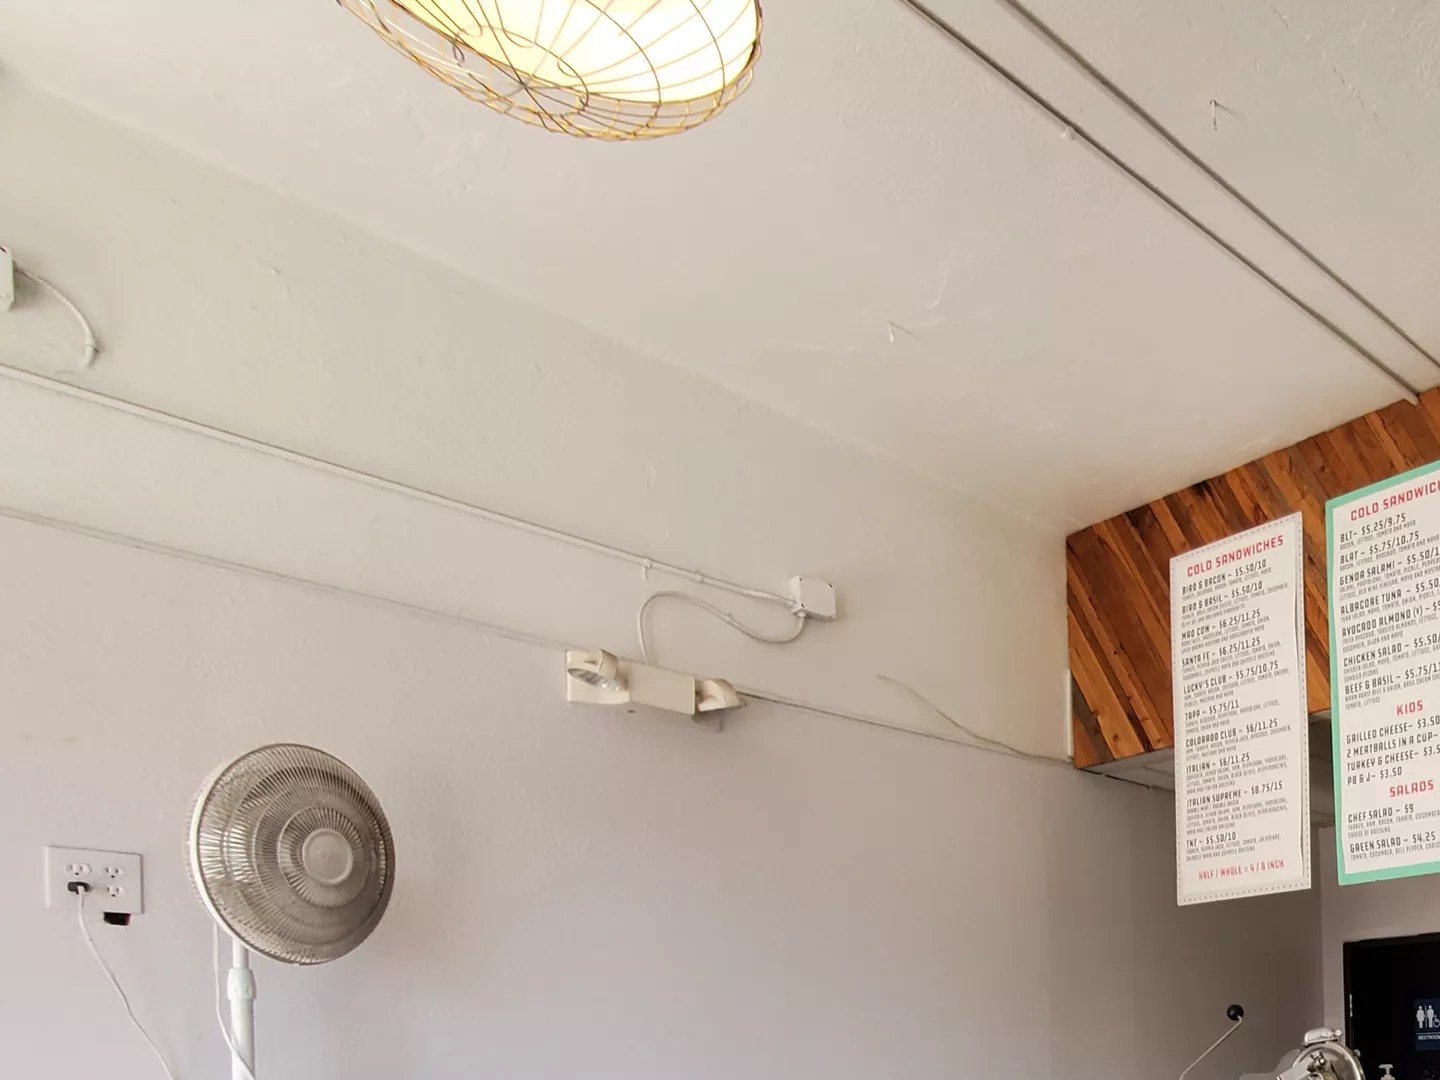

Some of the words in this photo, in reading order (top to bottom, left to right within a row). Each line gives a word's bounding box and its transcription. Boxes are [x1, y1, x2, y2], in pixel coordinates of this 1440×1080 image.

[1351, 502, 1379, 521] COLD
[1187, 560, 1212, 577] COLD
[1215, 535, 1283, 568] SANDWICHES
[1340, 570, 1365, 586] GENOA
[1367, 560, 1395, 578] SALAMI
[1340, 595, 1379, 615] ALBACORE
[1381, 589, 1402, 603] TUNA
[1183, 679, 1209, 694] LUCKY'S
[1210, 674, 1227, 687] CLUB
[1236, 660, 1278, 680] $5.75/10.75
[1396, 700, 1423, 716] KIDS
[1185, 732, 1219, 748] COLORADO
[1220, 728, 1237, 740] CLUB
[1246, 718, 1278, 734] $6/11.25
[1346, 729, 1377, 744] GRILLED
[1417, 715, 1440, 729] $3.50
[1186, 796, 1211, 808] ITALIAN
[1212, 788, 1241, 803] SUPREME
[1251, 780, 1283, 796] $8.75/15
[1389, 779, 1434, 797] SALADS
[1348, 811, 1366, 823] CHEF
[1368, 807, 1393, 820] SALAD
[1404, 803, 1414, 814] $9
